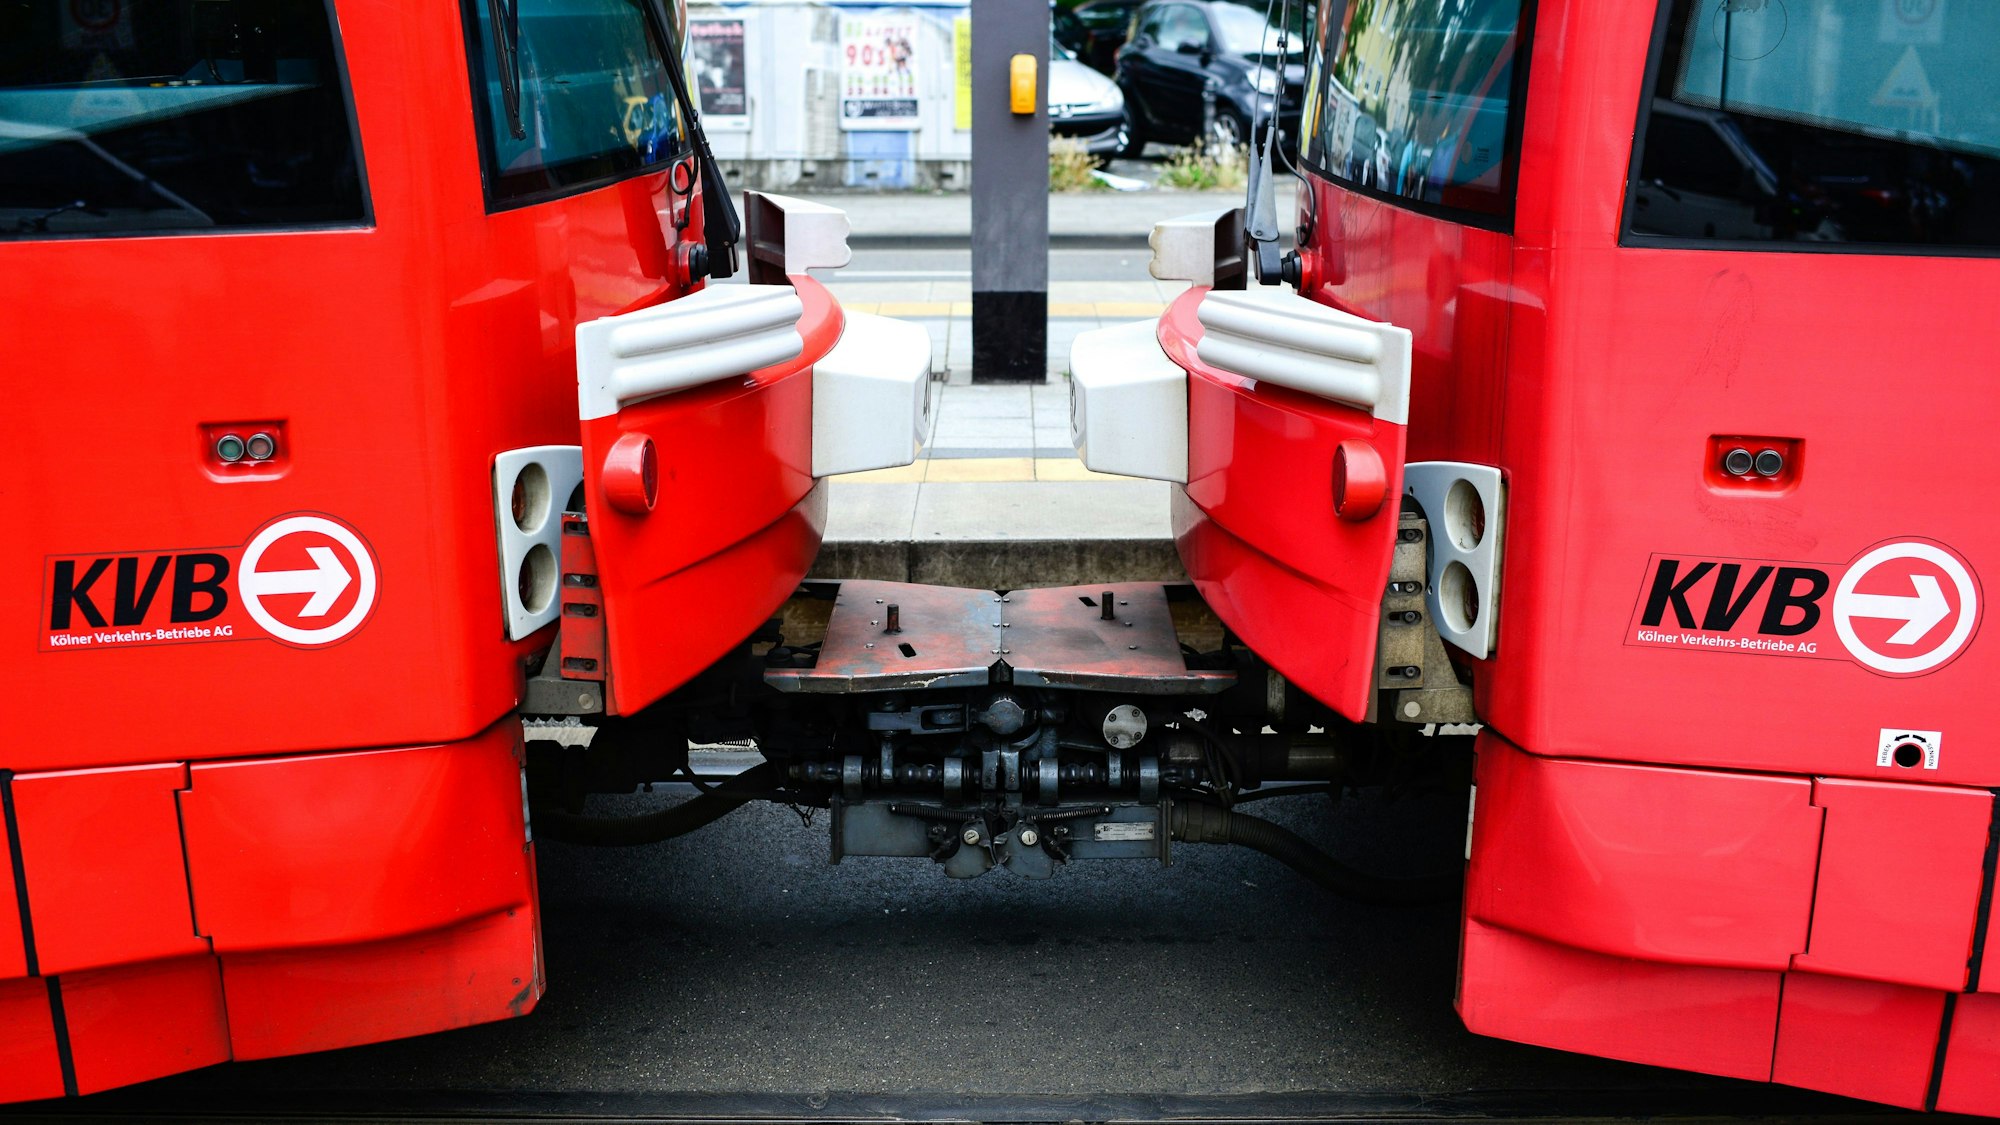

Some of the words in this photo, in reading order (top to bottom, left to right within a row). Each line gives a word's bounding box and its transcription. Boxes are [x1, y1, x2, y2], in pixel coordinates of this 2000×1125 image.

[50, 553, 230, 630] KVB
[1640, 559, 1830, 636] KVB
[50, 632, 92, 646] Kölner
[95, 627, 211, 644] Verkehrs-Betriebe
[214, 625, 233, 637] AG
[1637, 630, 1679, 644] Kölner
[1681, 633, 1795, 652] Verkehrs-Betriebe
[1797, 641, 1817, 654] AG
[1882, 743, 1892, 763] HEBEN
[1926, 743, 1934, 766] SENKEN
